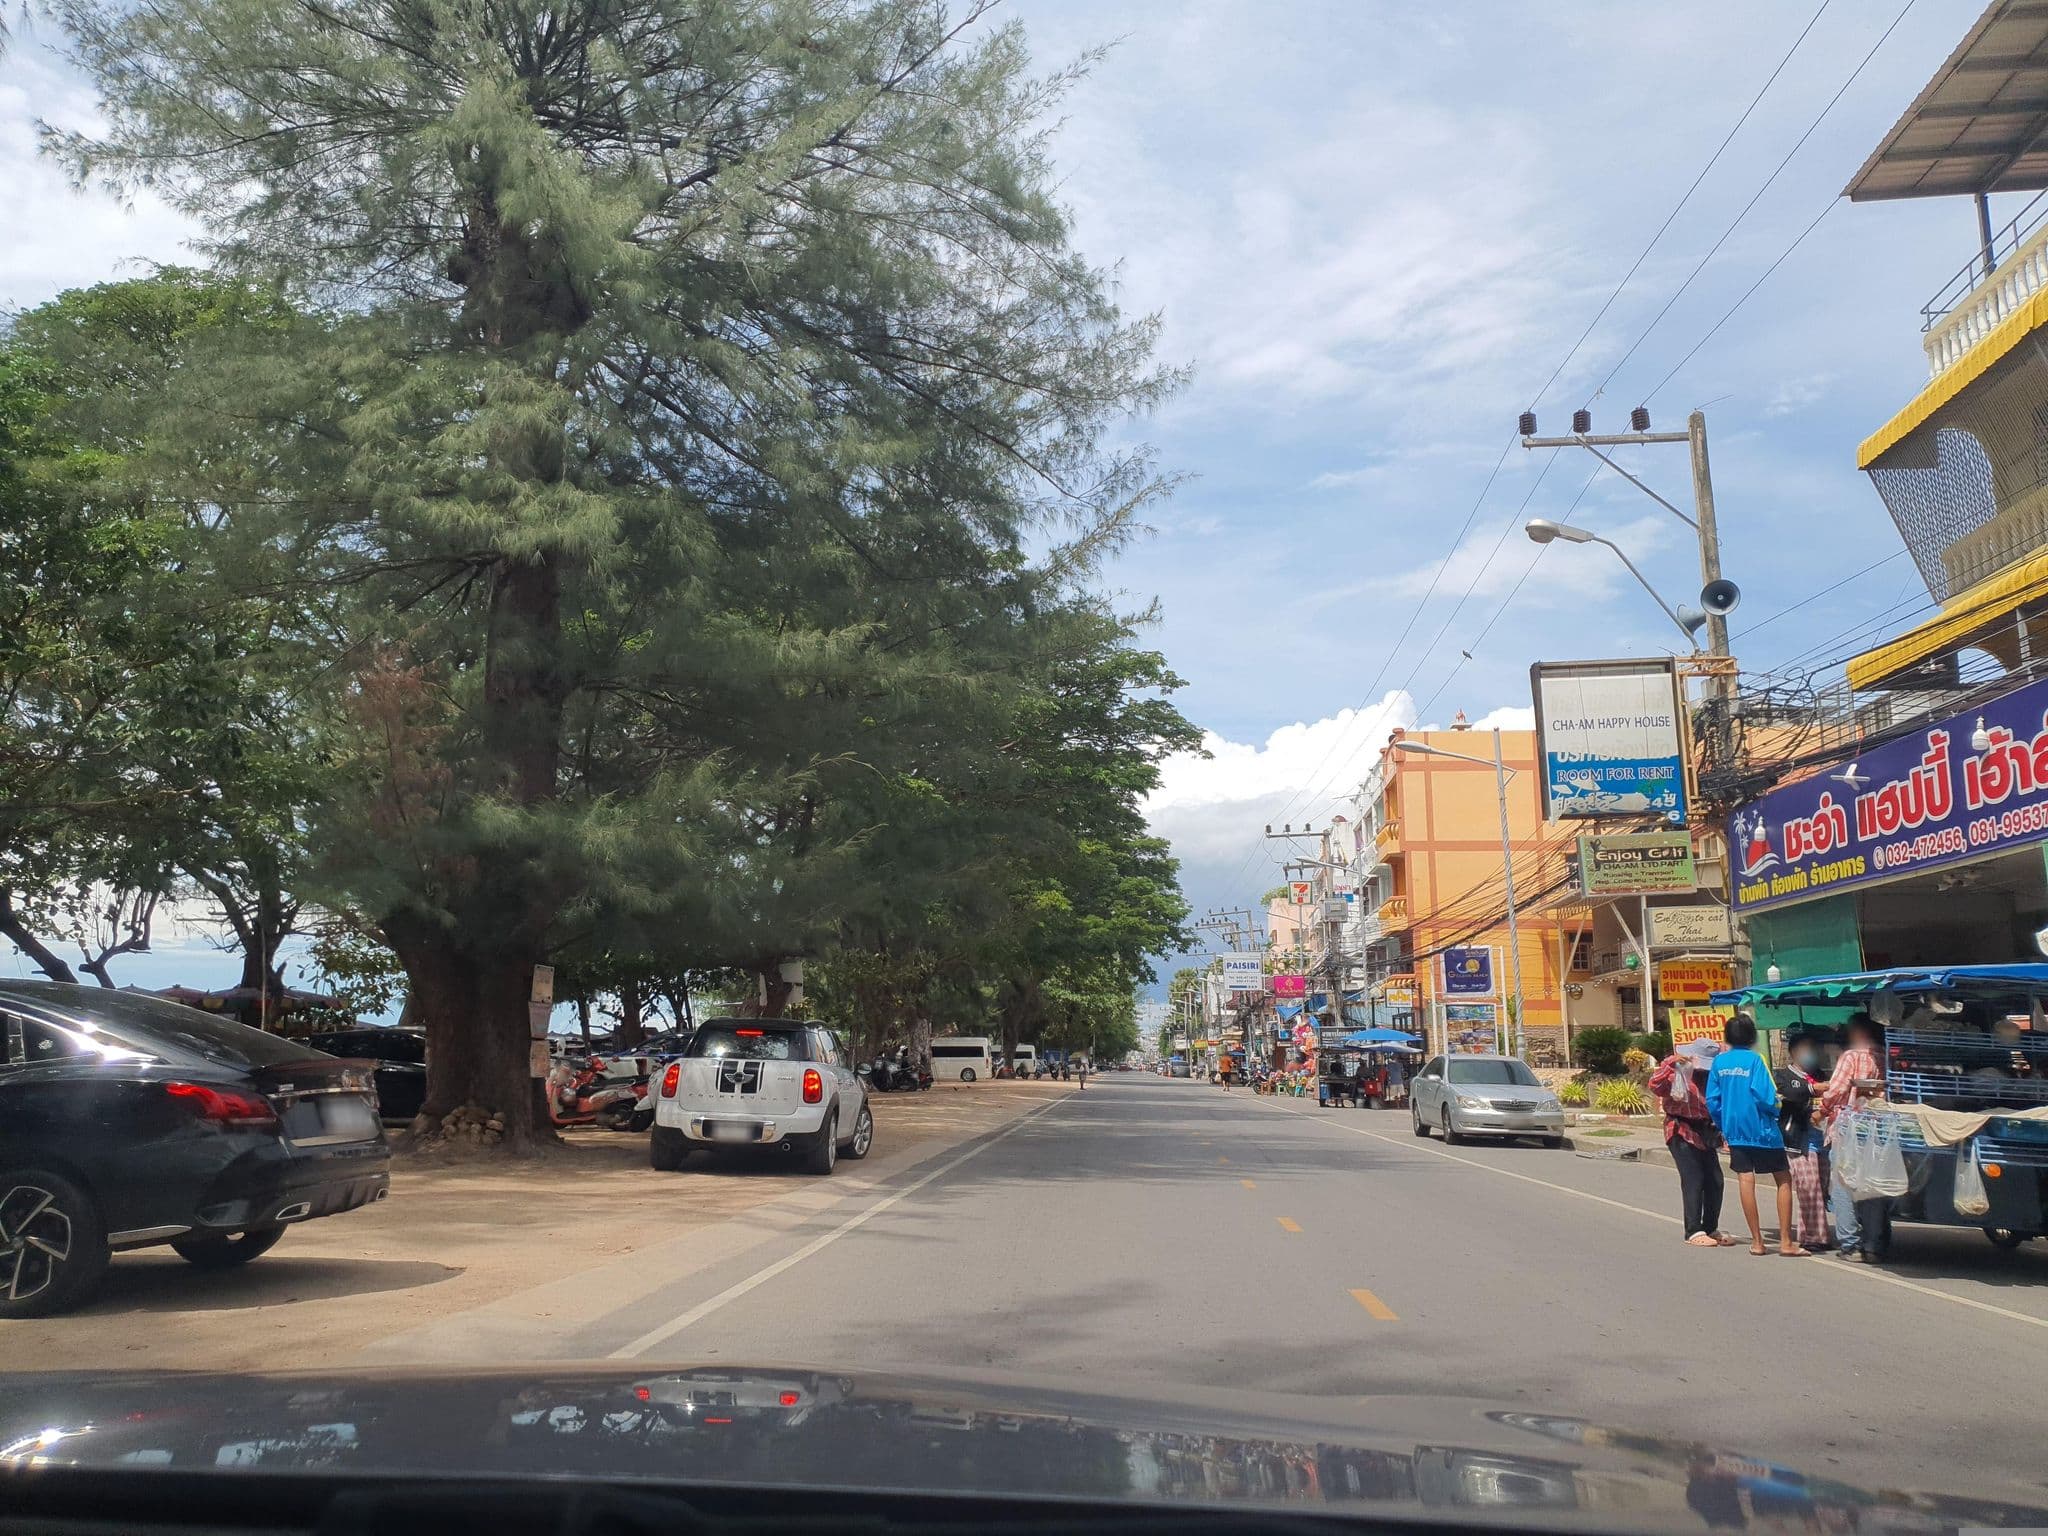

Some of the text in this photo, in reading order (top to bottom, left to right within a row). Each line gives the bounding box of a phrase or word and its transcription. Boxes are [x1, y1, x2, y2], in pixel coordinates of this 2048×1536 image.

[1552, 715, 1671, 732] CHA-AM HAPPY HOUSE
[1557, 766, 1675, 783] ROOM FOR RENT
[1783, 707, 2048, 864] ชะอำ แฮปปี้ เฮ้าส
[1596, 850, 1642, 862] Enjoy
[1603, 862, 1639, 870] CHA-AM
[1739, 855, 1866, 904] บ้านพัก ห้องพัก ร้านอาหาร
[1678, 925, 1703, 935] Thai
[1663, 934, 1719, 943] Restaurant
[1226, 961, 1259, 970] PAISIRI
[1706, 968, 1718, 980] 10
[1663, 982, 1680, 996] สุขา
[1678, 1008, 1727, 1030] ให้เช่า
